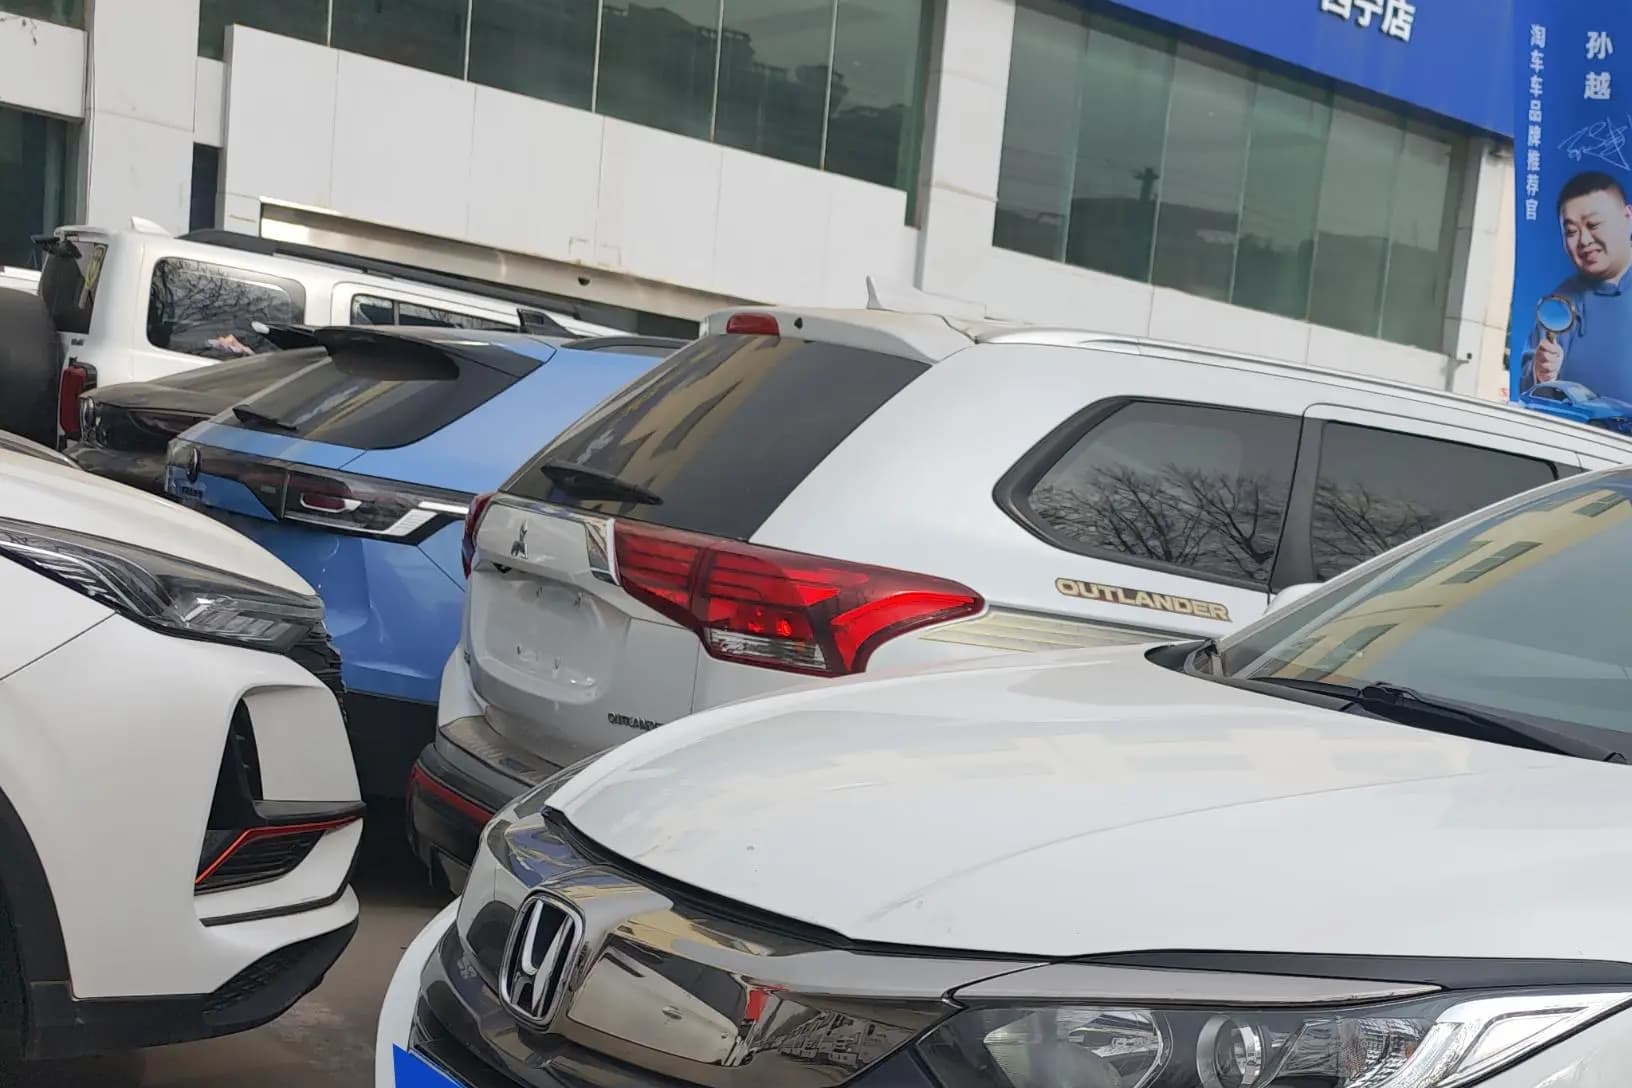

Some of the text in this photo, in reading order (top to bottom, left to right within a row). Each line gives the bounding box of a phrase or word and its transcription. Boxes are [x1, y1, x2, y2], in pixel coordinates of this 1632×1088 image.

[1584, 31, 1613, 99] 孙越
[1526, 24, 1546, 220] 淘车车品牌推荐官
[1056, 578, 1232, 621] OUTLANDER
